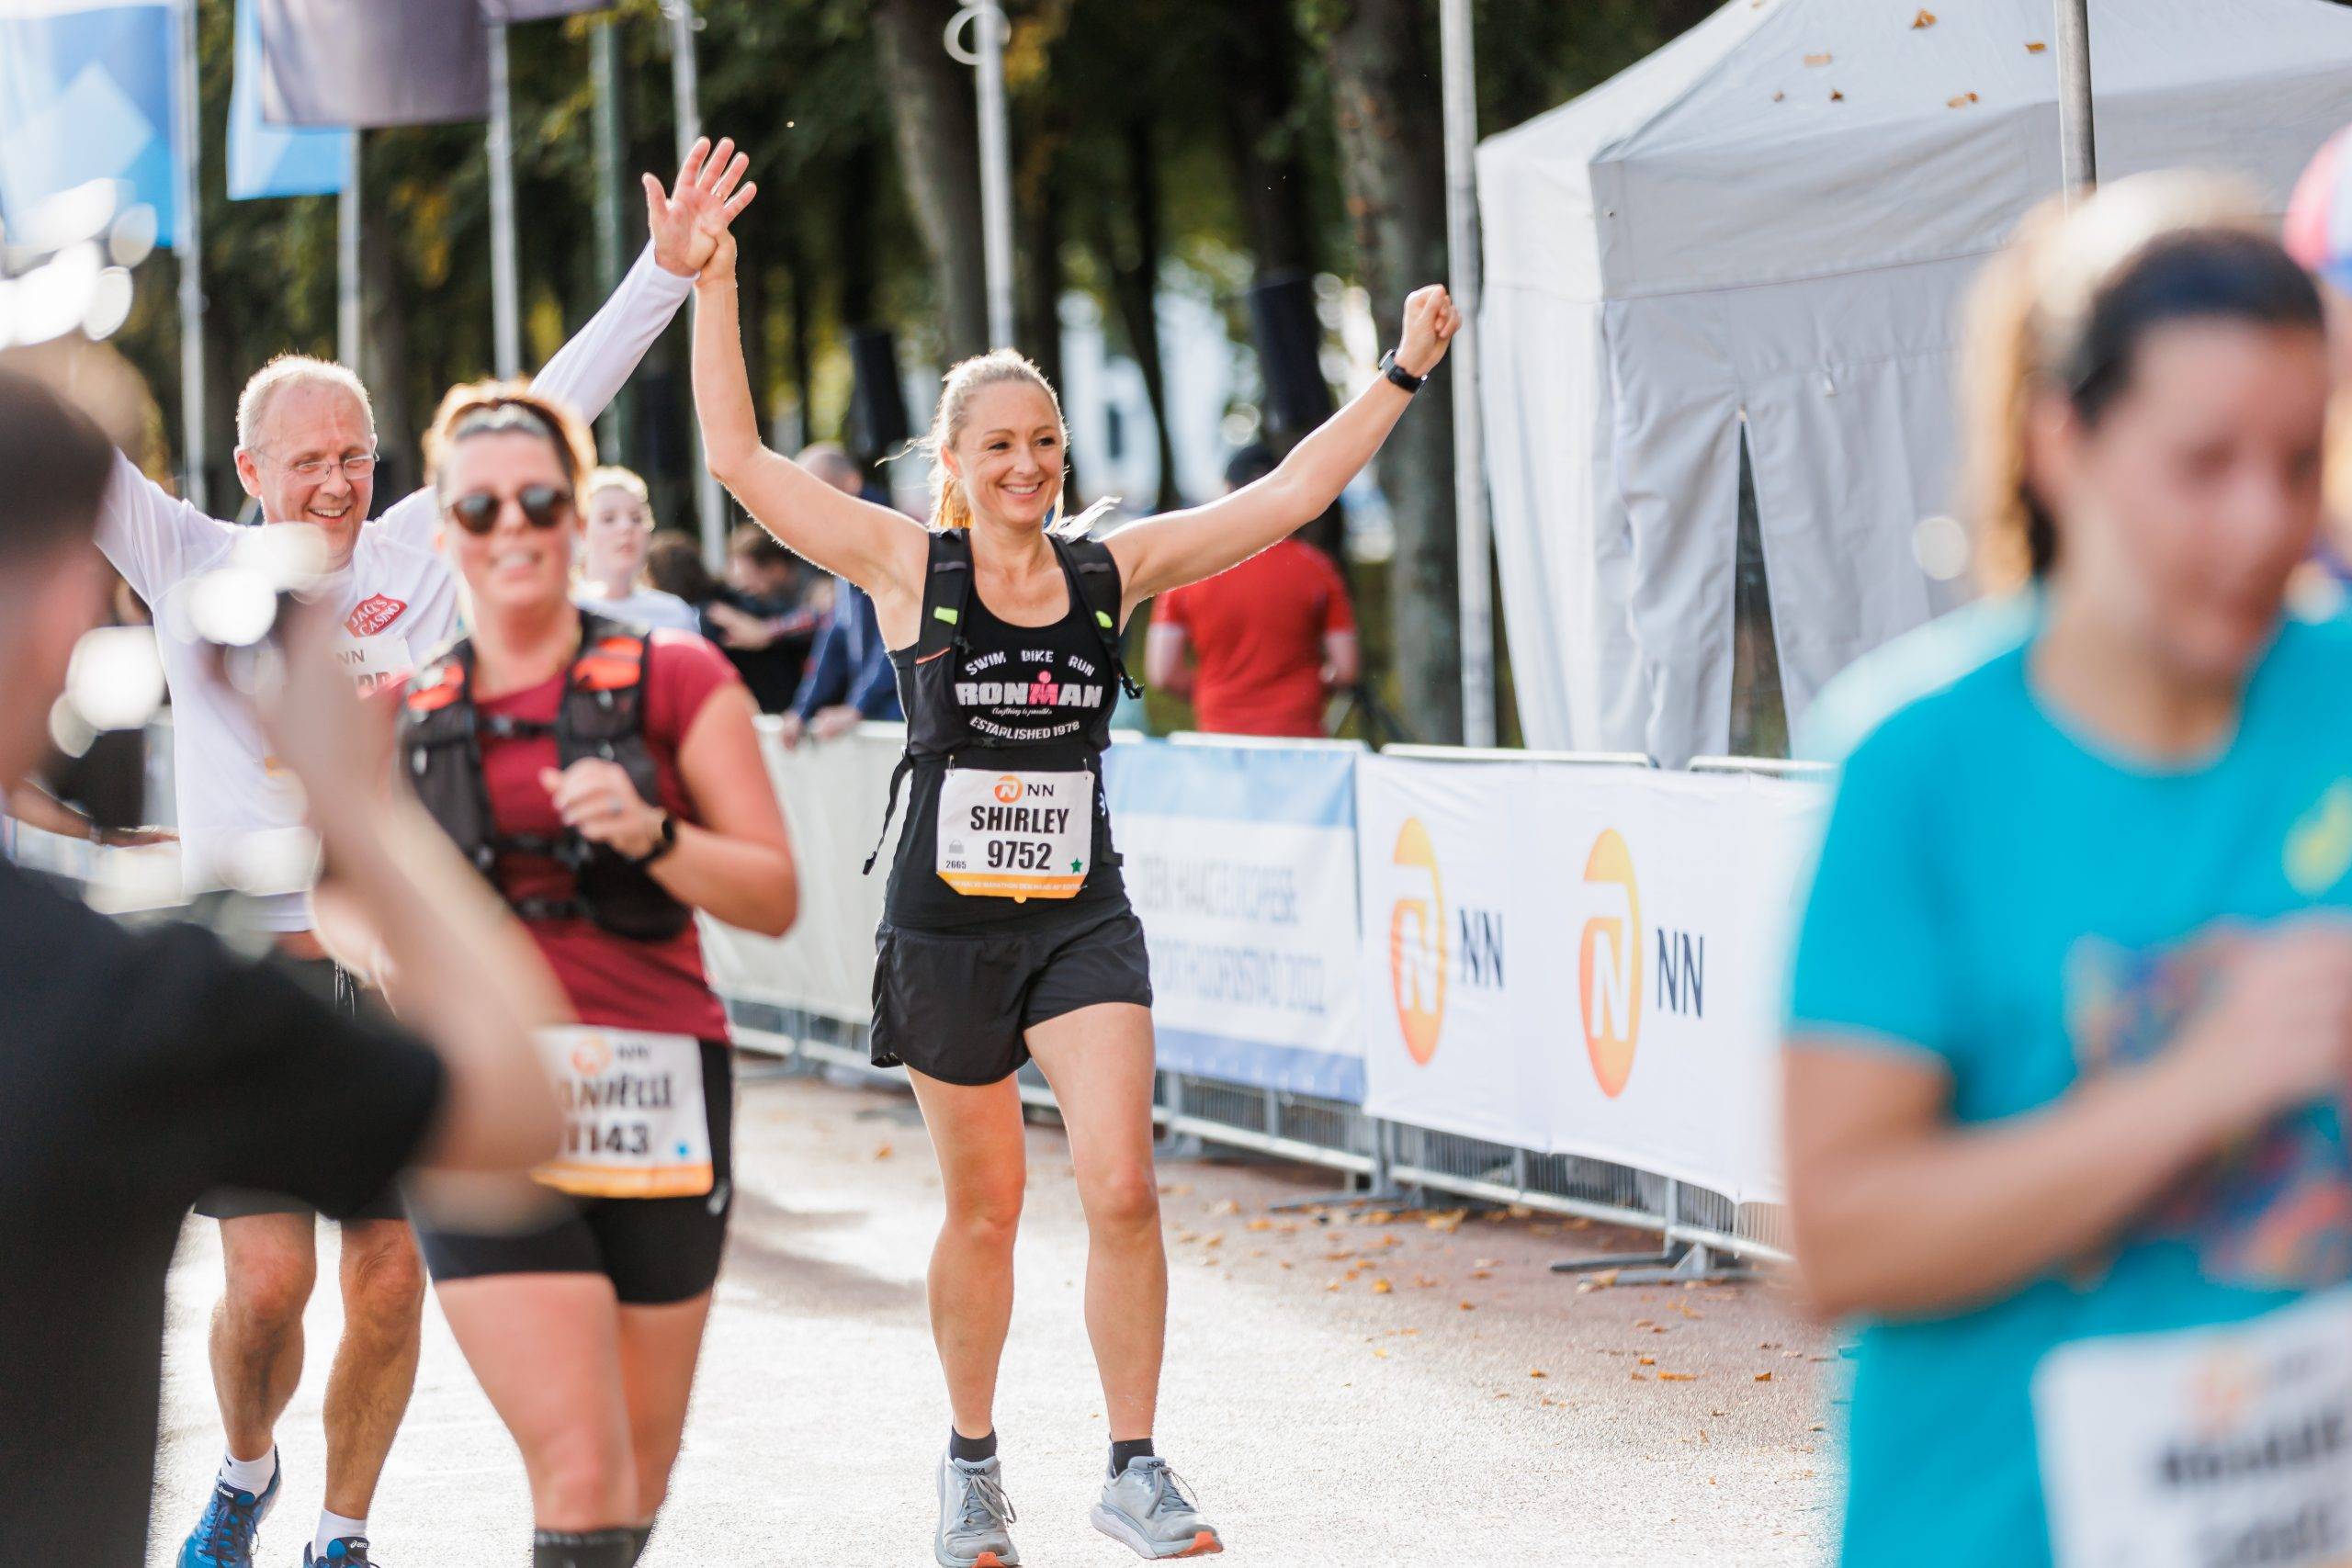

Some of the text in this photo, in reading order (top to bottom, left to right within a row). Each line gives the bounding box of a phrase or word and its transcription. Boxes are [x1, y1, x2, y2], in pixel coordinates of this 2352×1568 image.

[358, 603, 401, 636] CASINO
[966, 649, 1095, 677] SWIM BIKE RUN
[955, 670, 1102, 708] RONMAN
[969, 716, 1080, 740] ESTABLISHED 1978
[1027, 784, 1055, 797] NN
[970, 806, 1069, 834] SHIRLEY
[945, 860, 967, 870] 2665
[988, 840, 1053, 870] 9752
[1459, 908, 1504, 989] NN
[1657, 927, 1704, 1019] NN
[964, 1467, 986, 1475] HOKA
